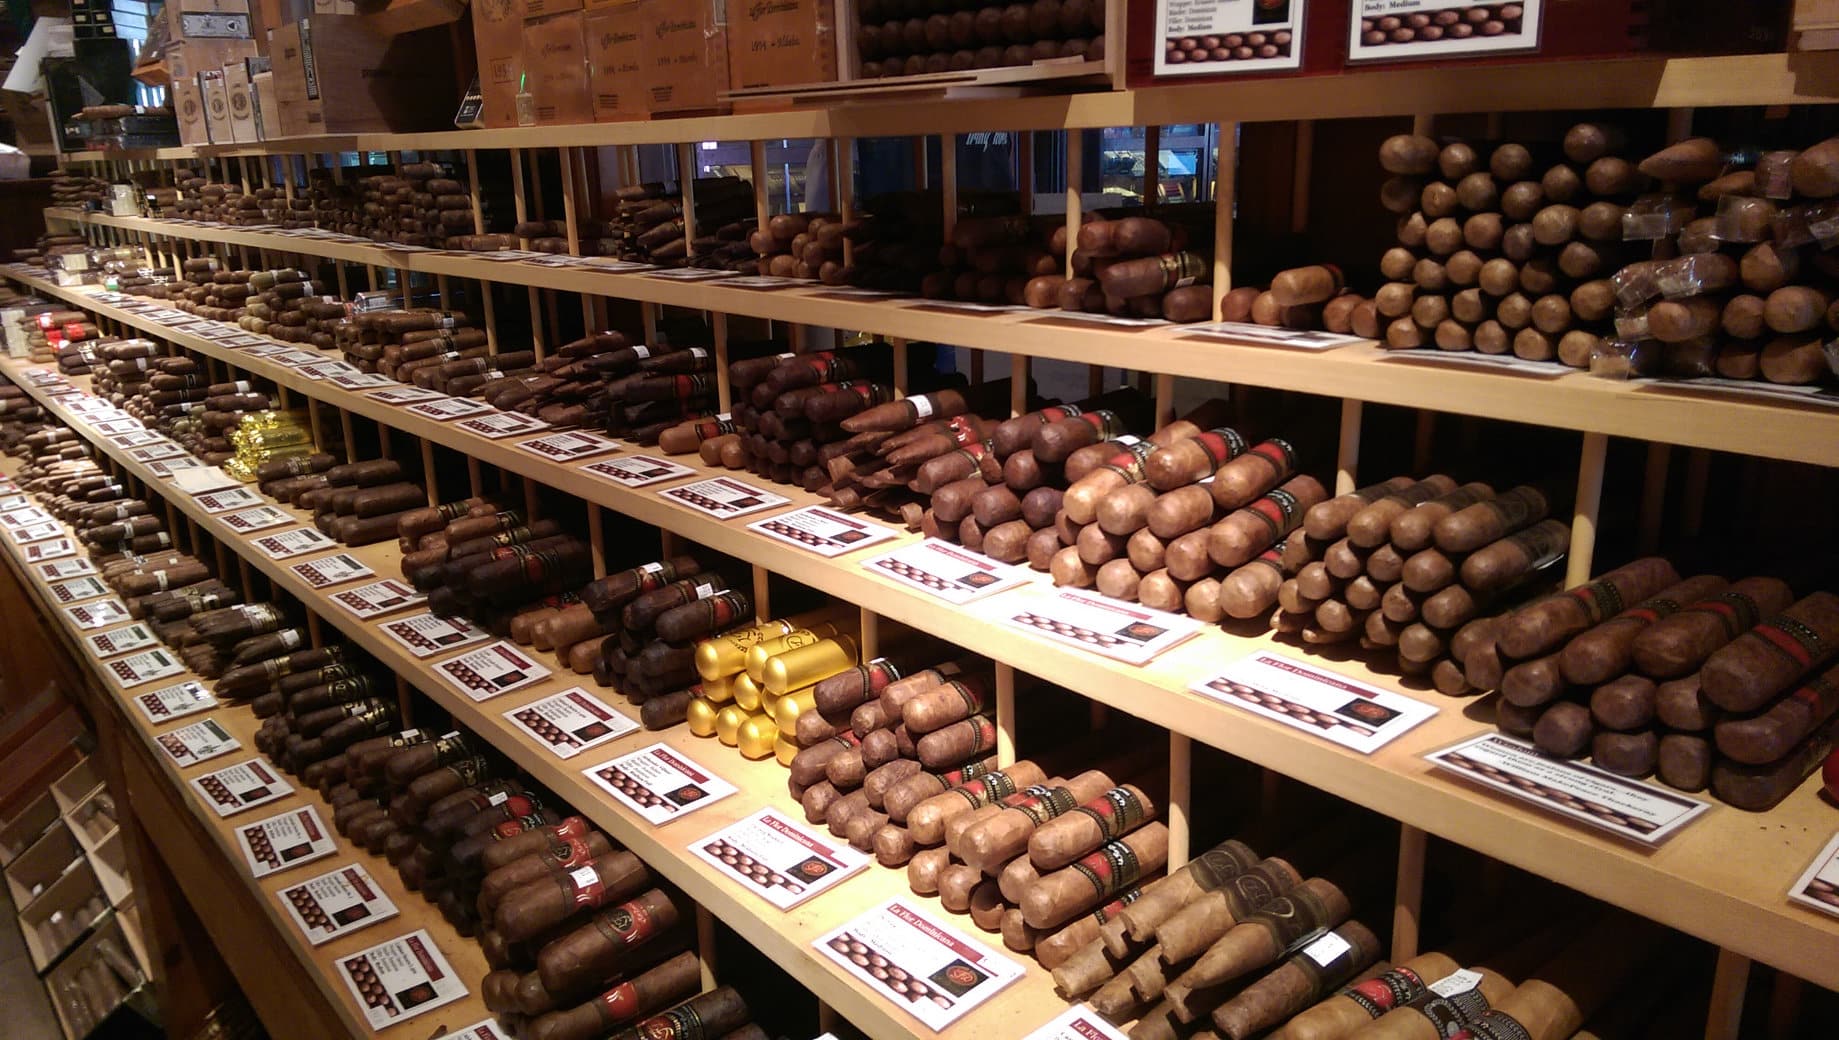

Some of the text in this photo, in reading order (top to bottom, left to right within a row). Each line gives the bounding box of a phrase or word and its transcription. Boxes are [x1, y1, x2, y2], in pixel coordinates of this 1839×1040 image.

[1389, 0, 1421, 8] Medium
[768, 819, 785, 830] Flor
[778, 826, 817, 848] Dominicana
[888, 904, 904, 914] La
[897, 910, 917, 923] Flor
[911, 918, 957, 947] Dominicana
[1074, 1020, 1087, 1033] La
